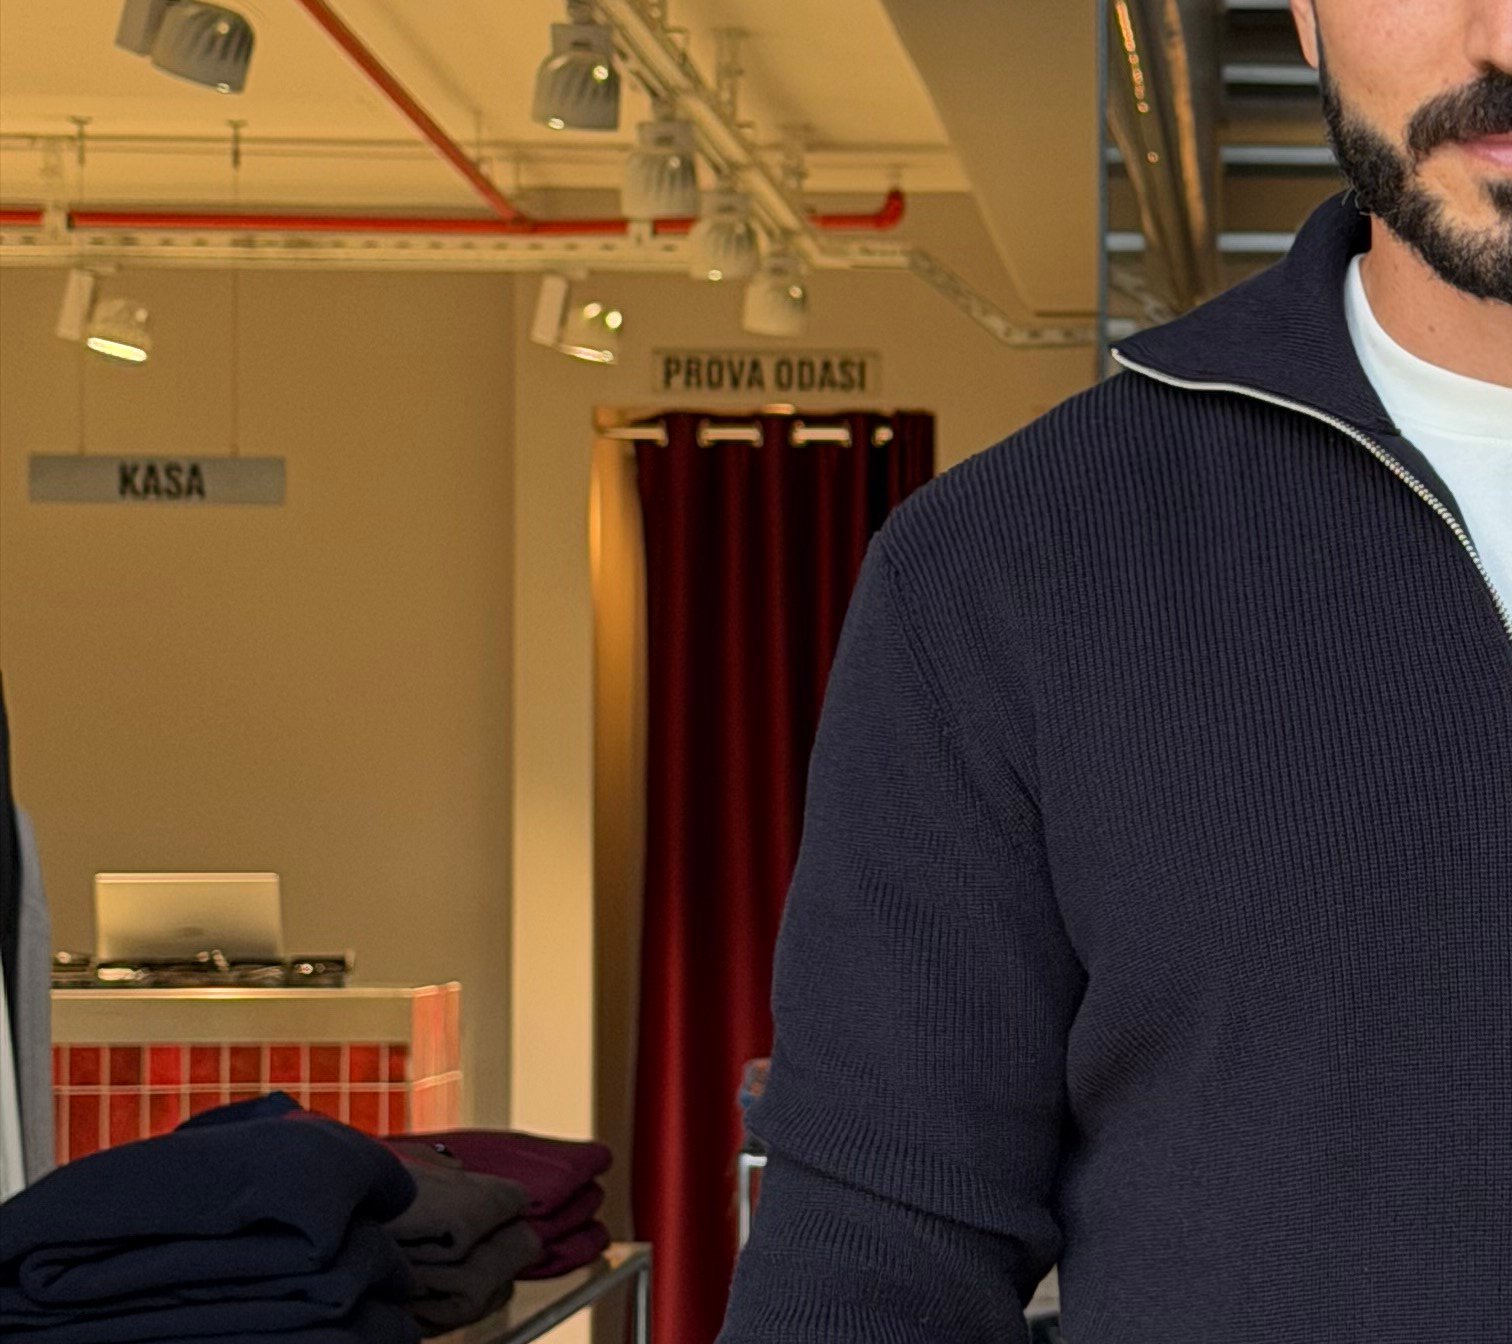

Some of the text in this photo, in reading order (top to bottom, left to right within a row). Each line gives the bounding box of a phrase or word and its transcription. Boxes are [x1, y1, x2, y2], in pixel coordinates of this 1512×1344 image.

[664, 357, 866, 391] PROVA ODASI
[118, 462, 206, 498] KASA
